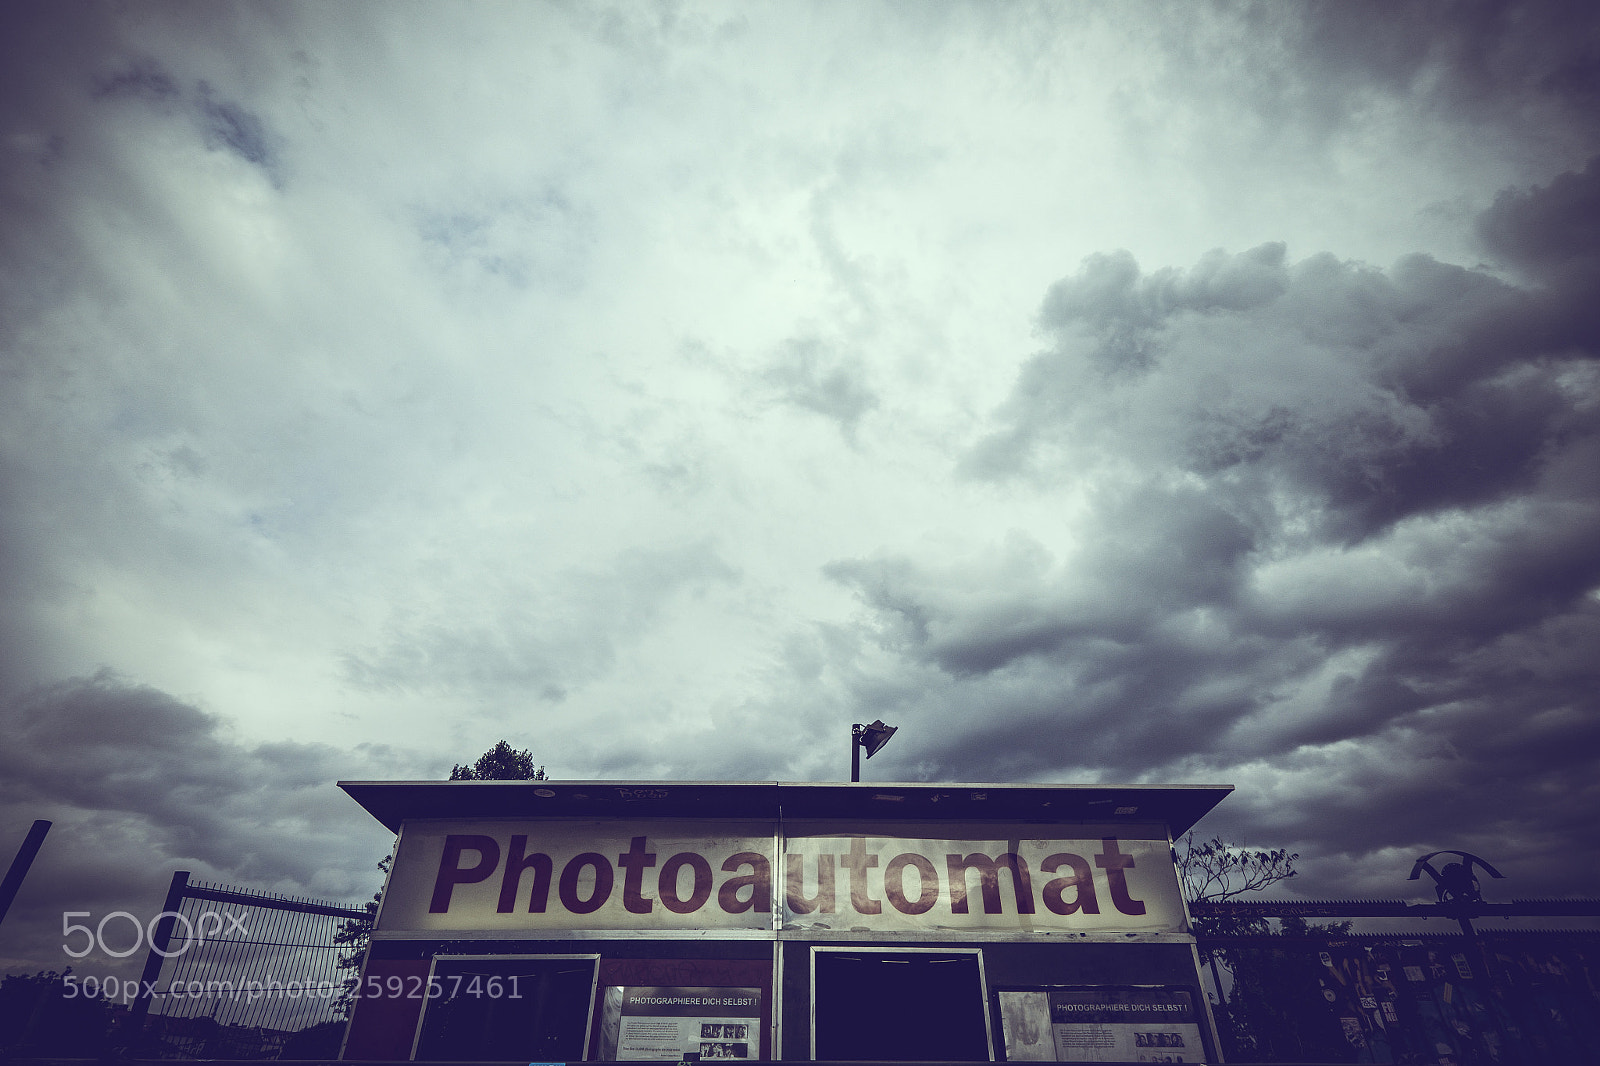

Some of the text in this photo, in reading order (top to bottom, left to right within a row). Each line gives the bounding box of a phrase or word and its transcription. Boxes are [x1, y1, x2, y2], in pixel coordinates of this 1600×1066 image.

[428, 834, 1147, 916] Photoautomat
[630, 997, 701, 1005] PHOTOGRAPHIERE
[702, 998, 721, 1006] DICH
[723, 998, 753, 1006] SELBST
[1057, 1004, 1130, 1012] PHOTOGRAPHIERE
[1131, 1004, 1150, 1012] DICH
[1152, 1004, 1182, 1012] SELBST
